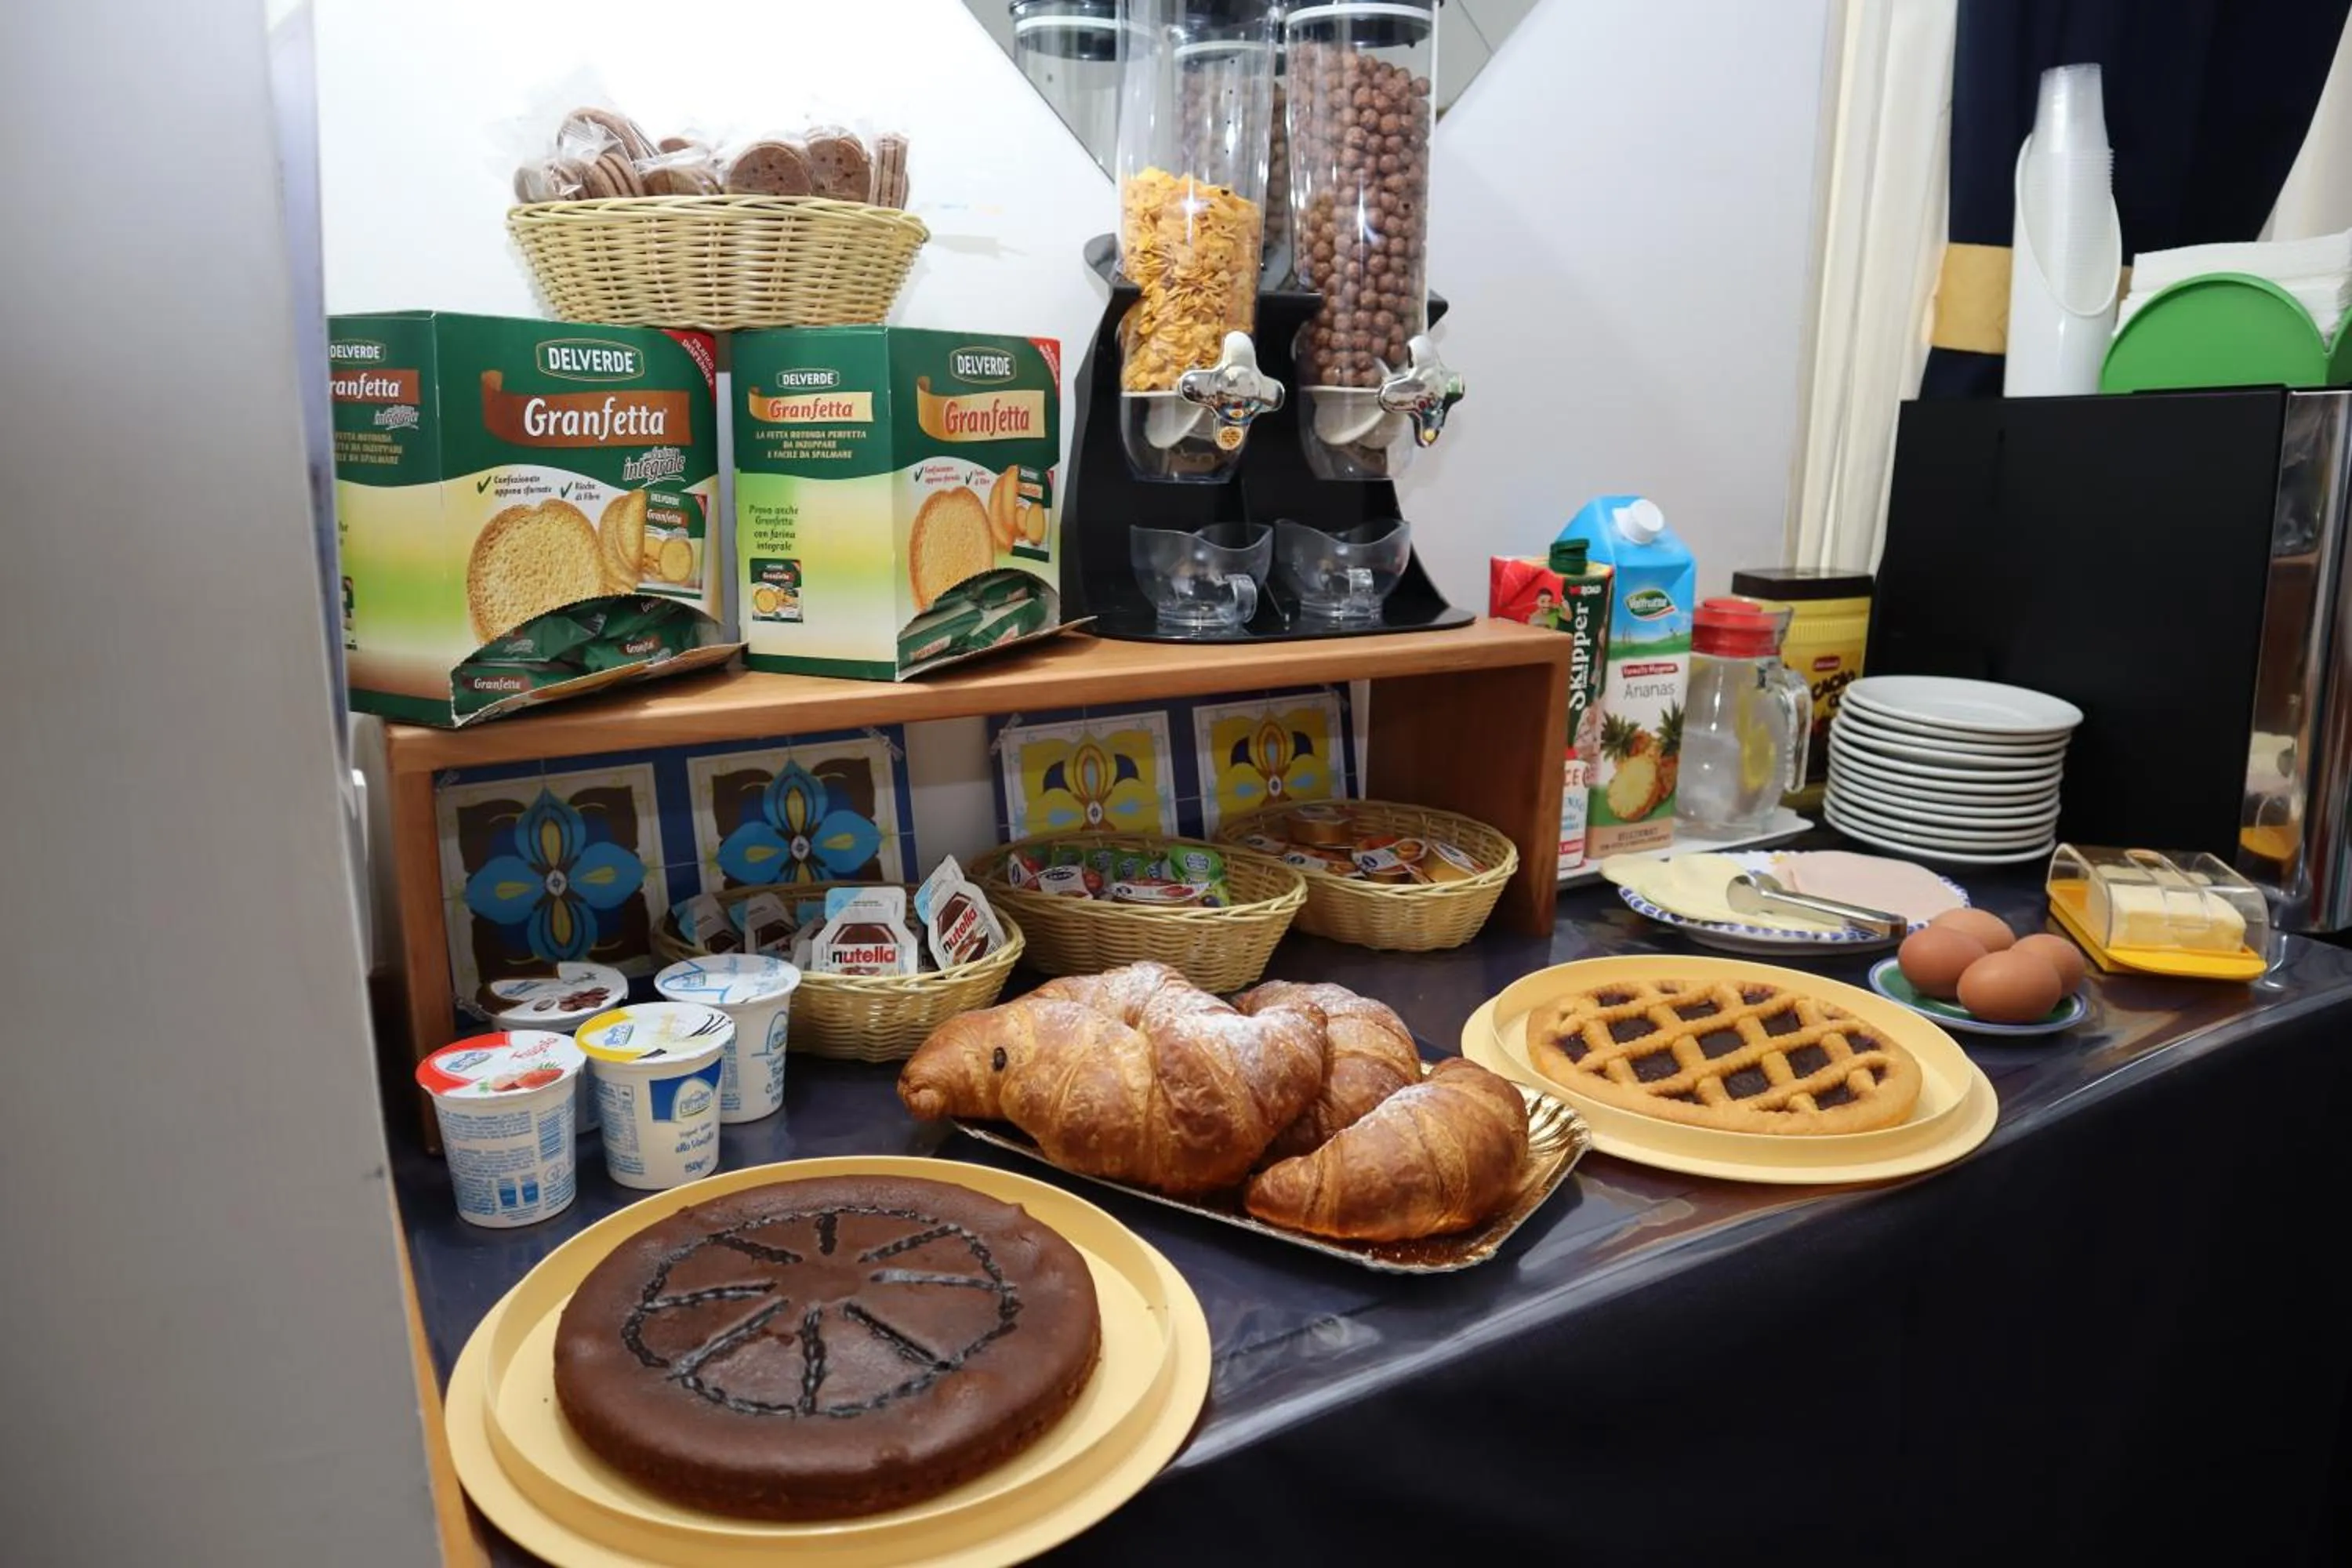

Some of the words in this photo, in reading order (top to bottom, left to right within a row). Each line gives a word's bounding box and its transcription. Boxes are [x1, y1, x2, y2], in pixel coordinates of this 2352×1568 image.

[329, 344, 381, 360] DELVERDE
[548, 346, 635, 374] DELVERDE
[956, 354, 1011, 376] DELVERDE
[329, 372, 401, 399] ranfetta
[782, 372, 835, 386] DELVERDE
[769, 397, 854, 421] Granfetta
[944, 398, 1030, 437] Granfetta
[524, 396, 666, 440] Granfetta
[766, 430, 788, 440] FETTA
[826, 430, 867, 439] PERFETTA
[622, 456, 686, 481] integrale
[646, 508, 682, 525] Granfetta
[749, 503, 772, 515] Prova
[775, 504, 799, 515] anche
[755, 515, 794, 528] Granfetta
[753, 530, 769, 539] con
[769, 529, 797, 541] farina
[757, 542, 793, 554] integrale
[1569, 601, 1592, 711] Skipper
[474, 677, 521, 691] Granfetta
[1623, 683, 1676, 700] Ananas
[943, 908, 978, 954] nutella
[832, 946, 896, 964] nutella
